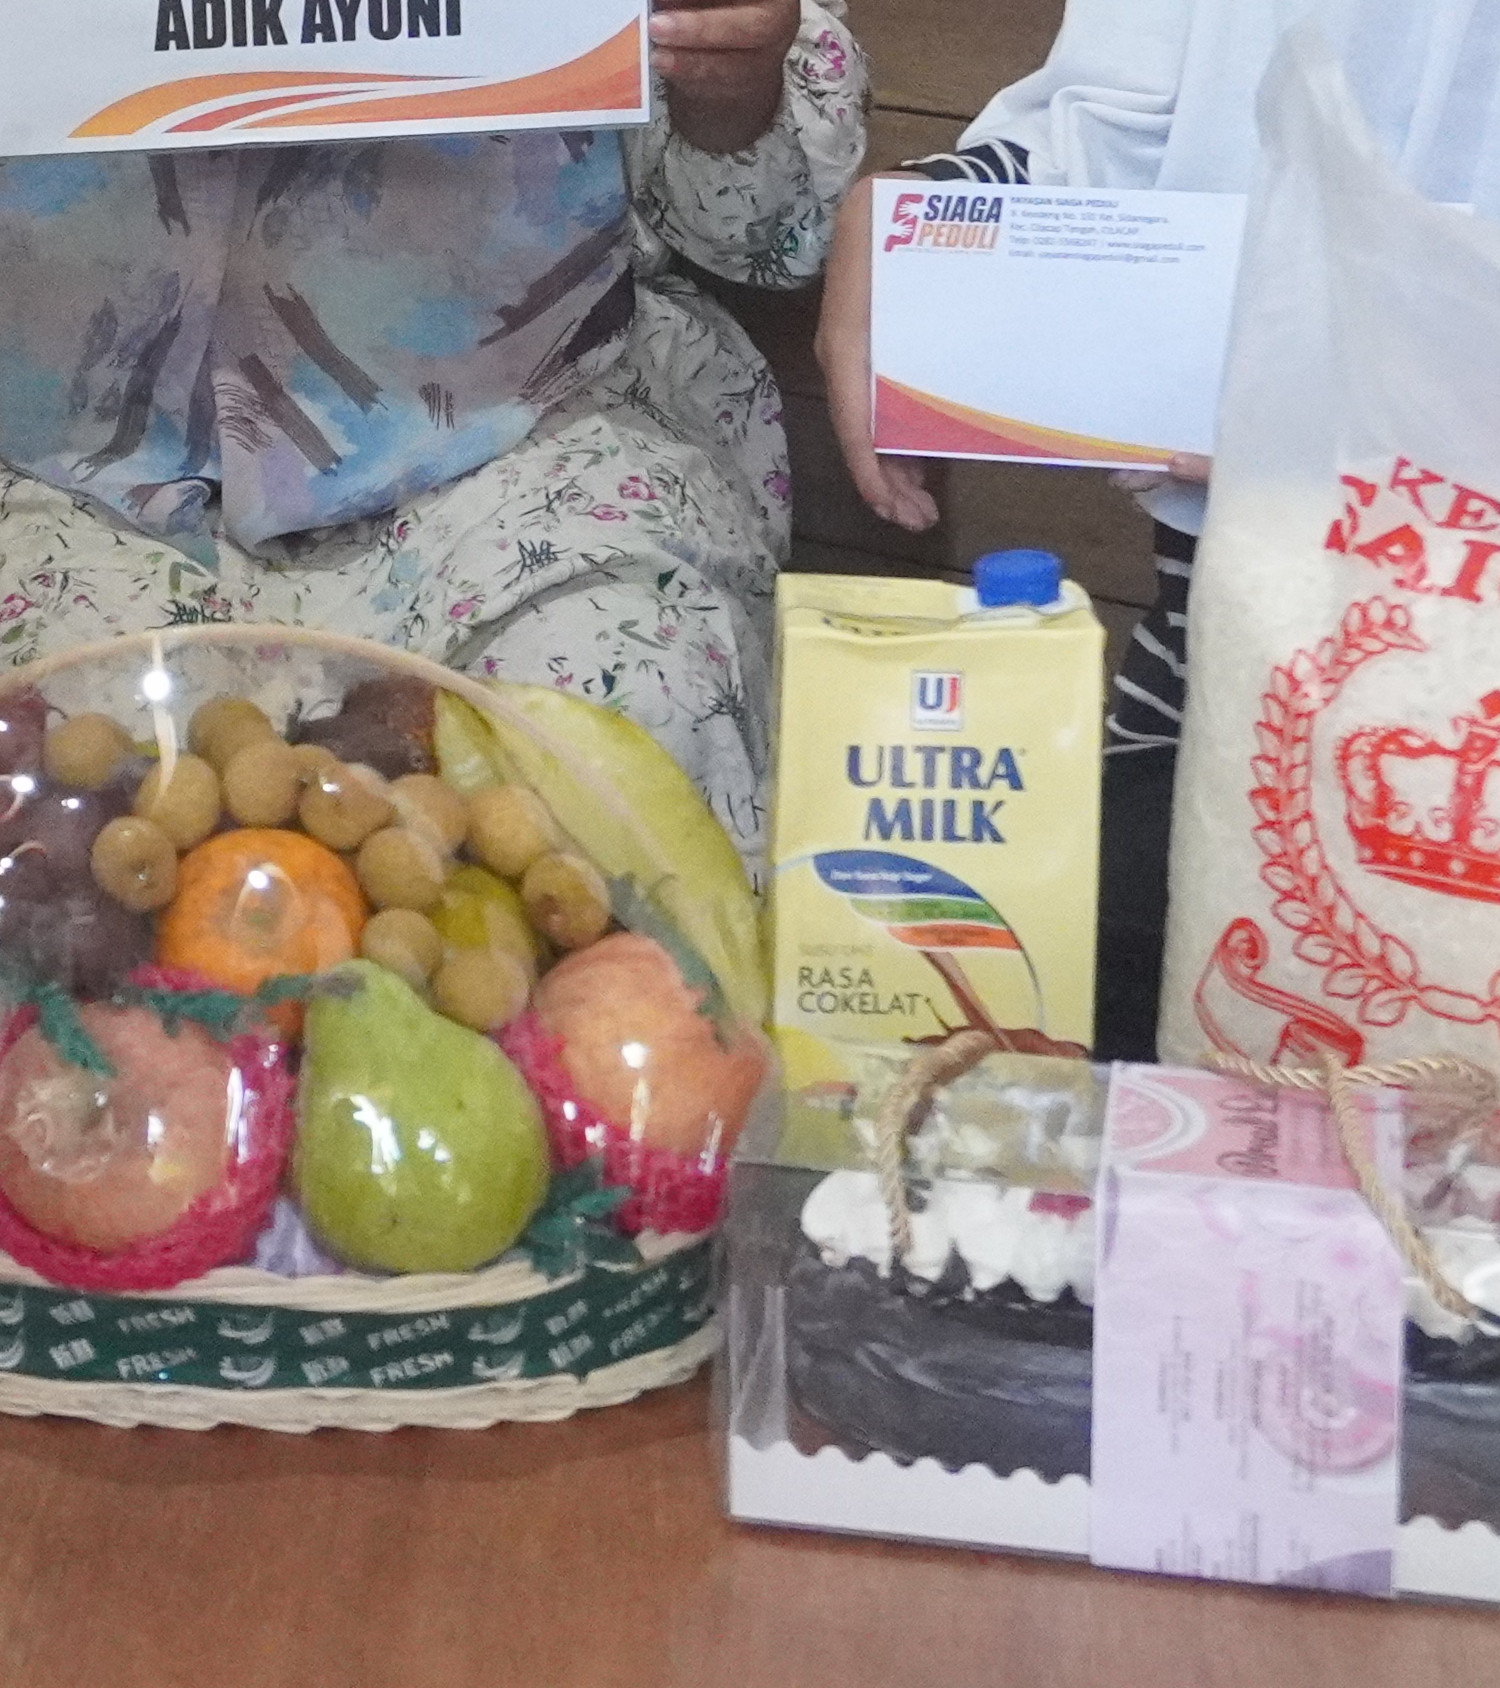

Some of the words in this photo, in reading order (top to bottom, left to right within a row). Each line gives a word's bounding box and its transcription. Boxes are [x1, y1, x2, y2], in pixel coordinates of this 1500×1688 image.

[923, 194, 1004, 223] SIAGA
[917, 223, 1000, 250] PEDULI
[846, 745, 1024, 792] ULTRA
[864, 797, 1007, 844] MILK
[798, 966, 876, 990] RASA
[797, 991, 922, 1017] COKELAT
[369, 1352, 455, 1387] FRESH
